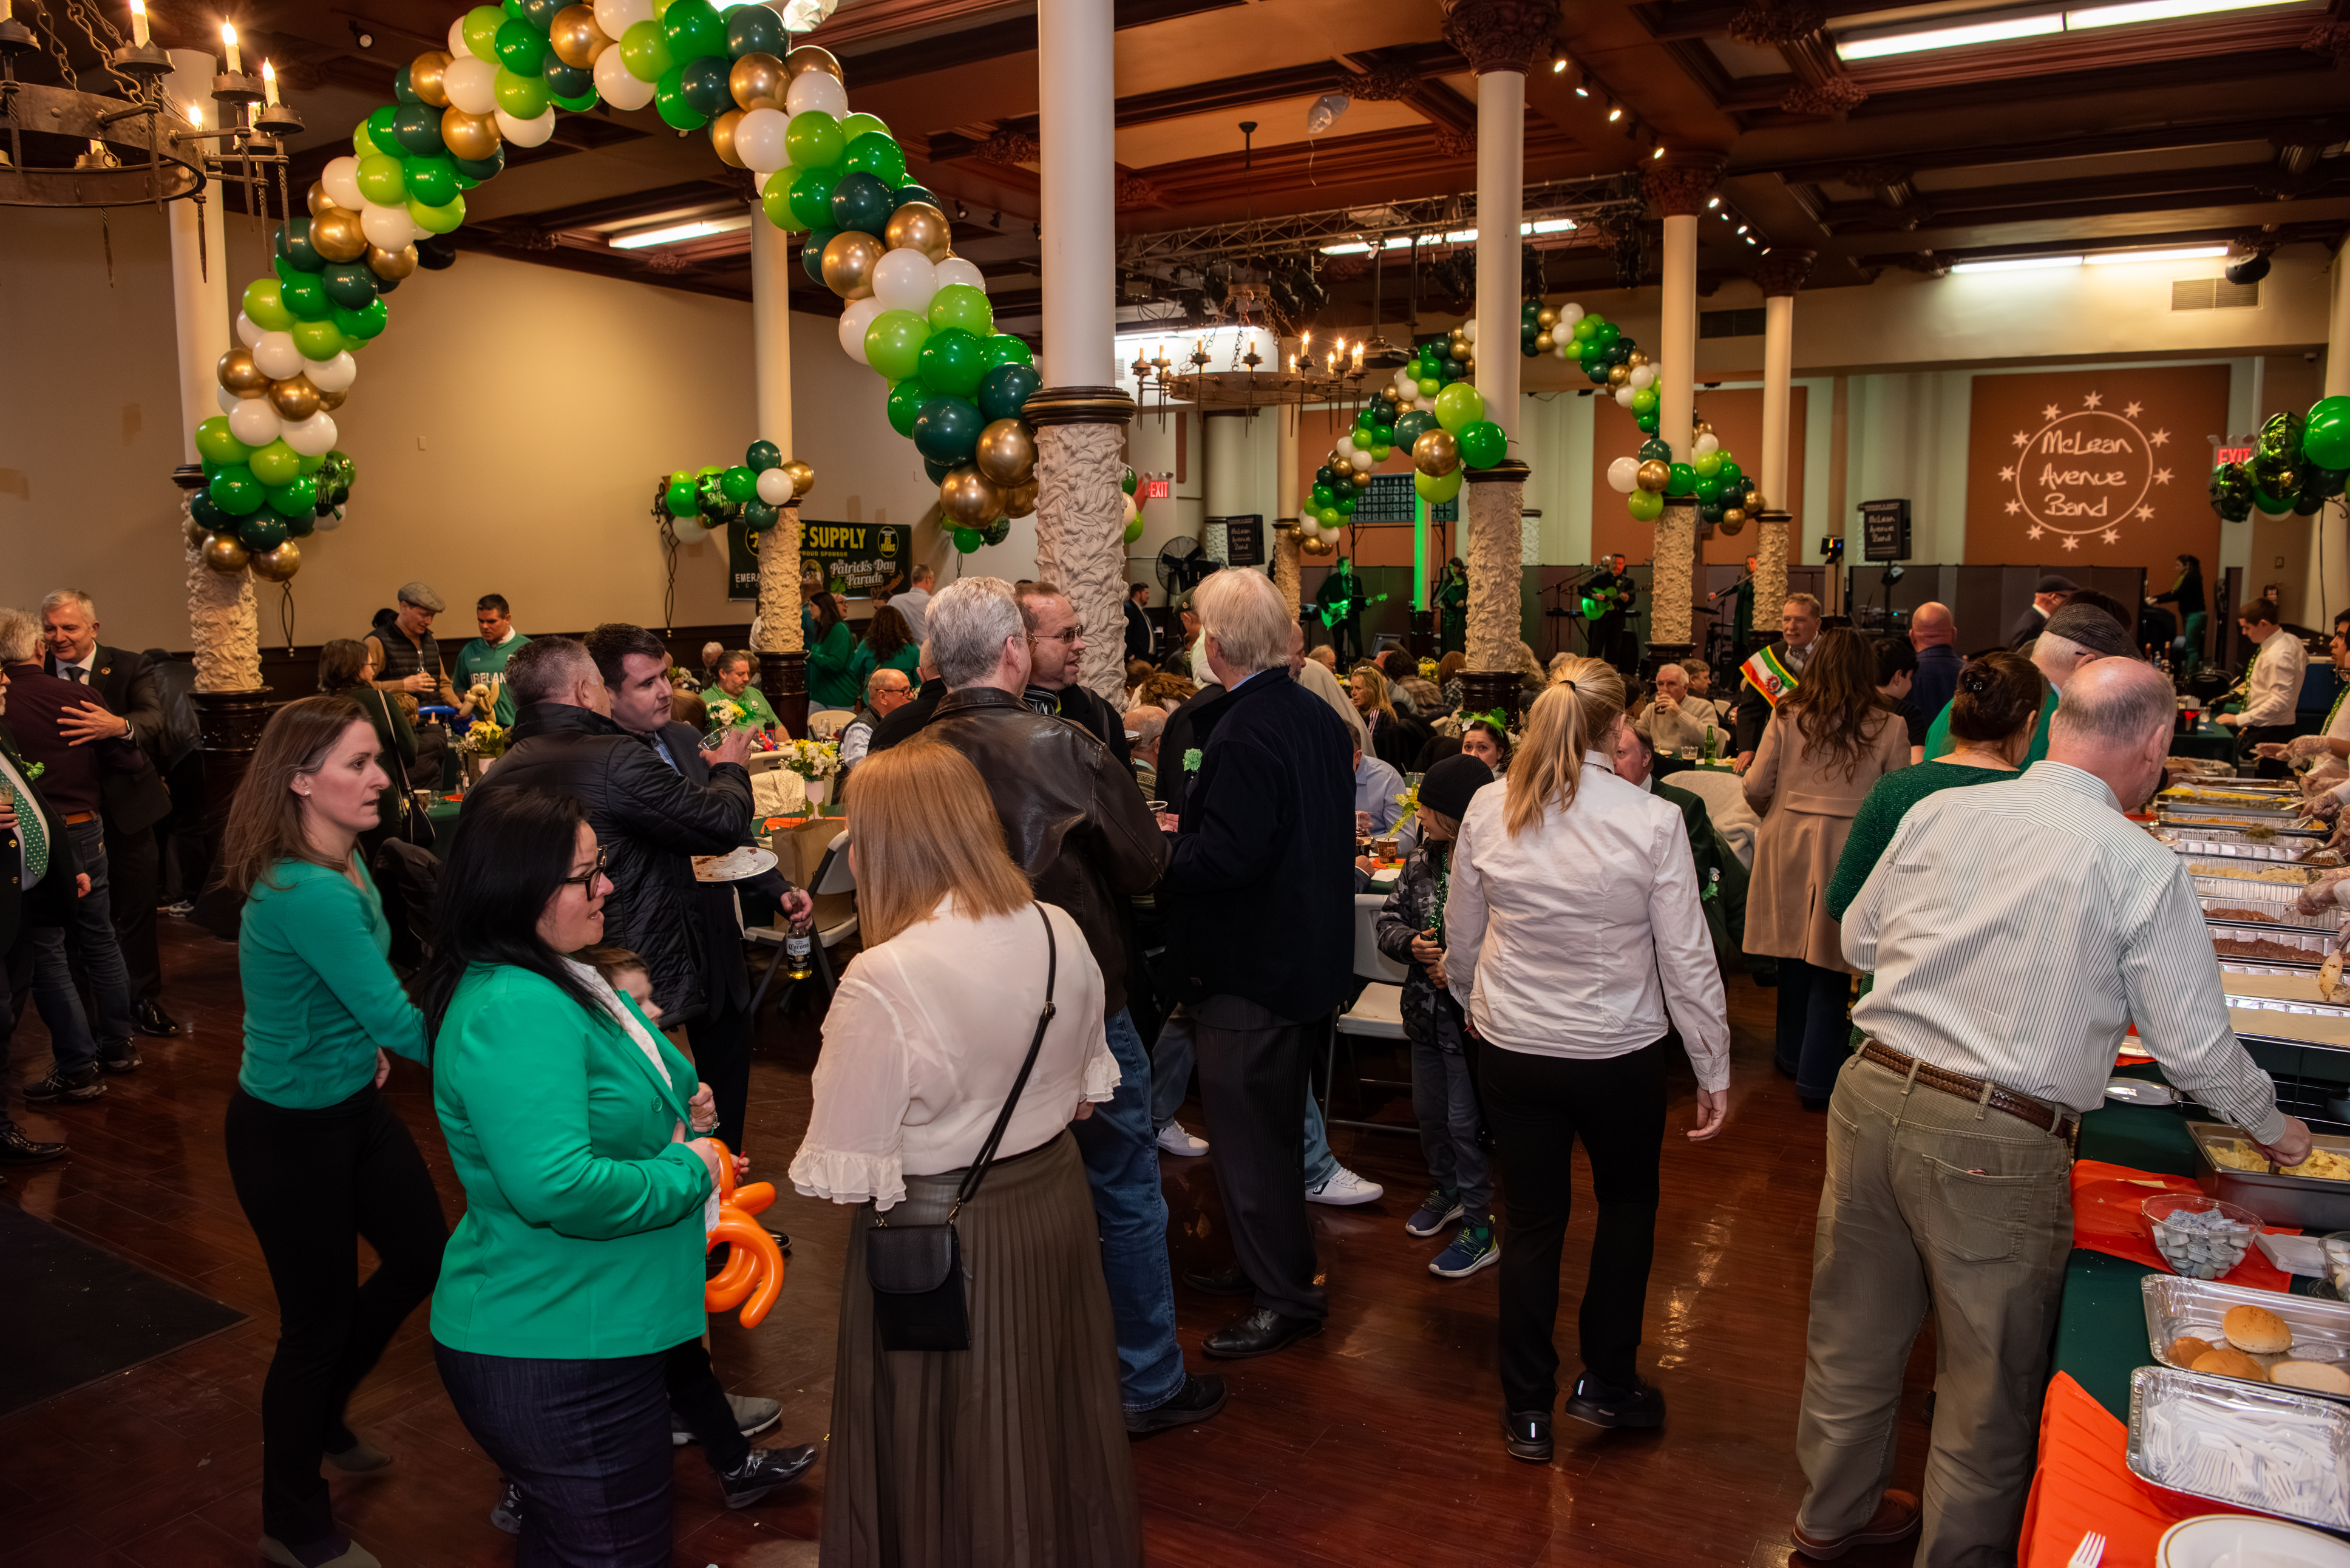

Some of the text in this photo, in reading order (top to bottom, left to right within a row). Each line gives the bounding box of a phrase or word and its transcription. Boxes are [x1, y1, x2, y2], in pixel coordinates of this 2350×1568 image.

[2040, 429, 2133, 455] McLean
[2218, 448, 2251, 466] EXIT
[2039, 462, 2127, 490] Avenue
[1150, 481, 1169, 498] EXIT
[2044, 492, 2108, 517] Band
[1869, 514, 1895, 524] McLean
[809, 526, 866, 549] SUPPLY
[830, 558, 896, 575] Patrick's Day
[846, 572, 884, 586] Parade
